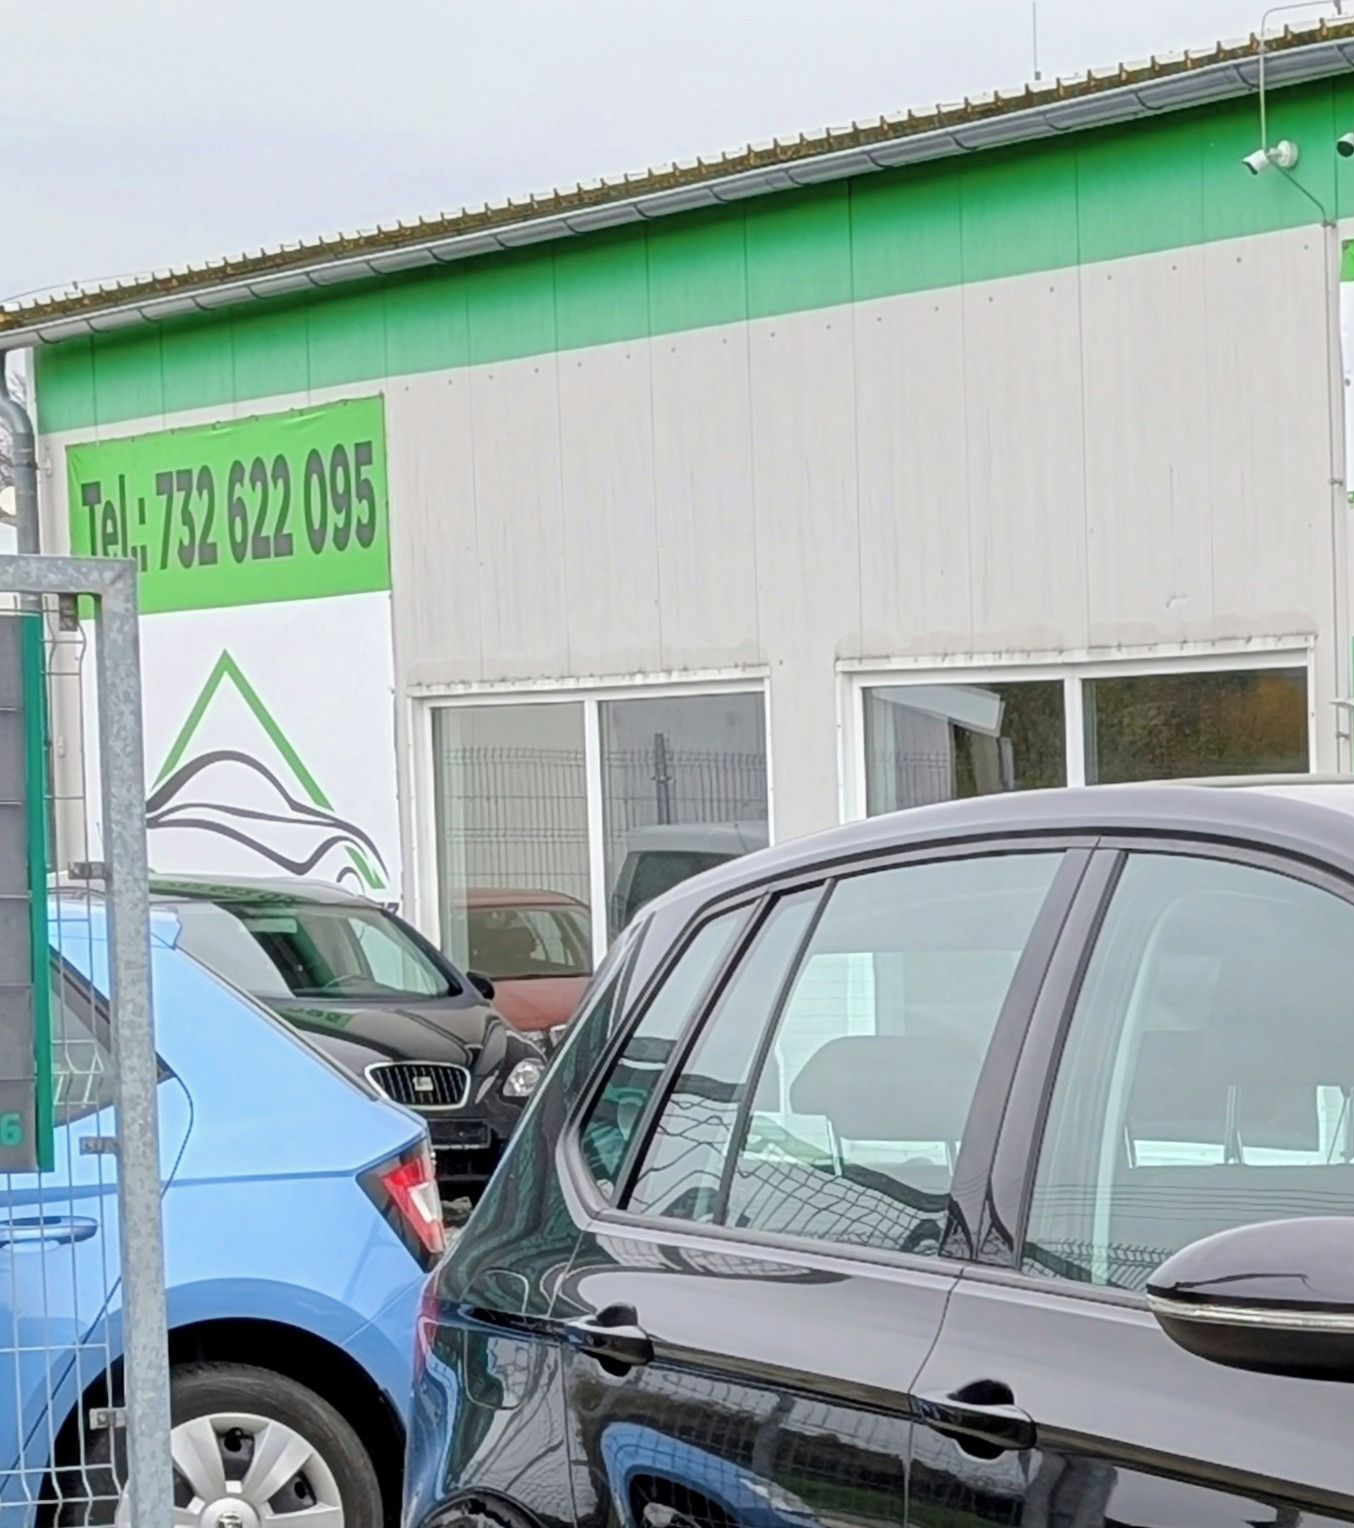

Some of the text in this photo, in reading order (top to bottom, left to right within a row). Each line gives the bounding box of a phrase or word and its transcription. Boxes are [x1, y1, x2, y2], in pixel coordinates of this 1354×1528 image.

[155, 469, 218, 571] 732
[227, 453, 293, 564] 622
[303, 440, 376, 555] 095
